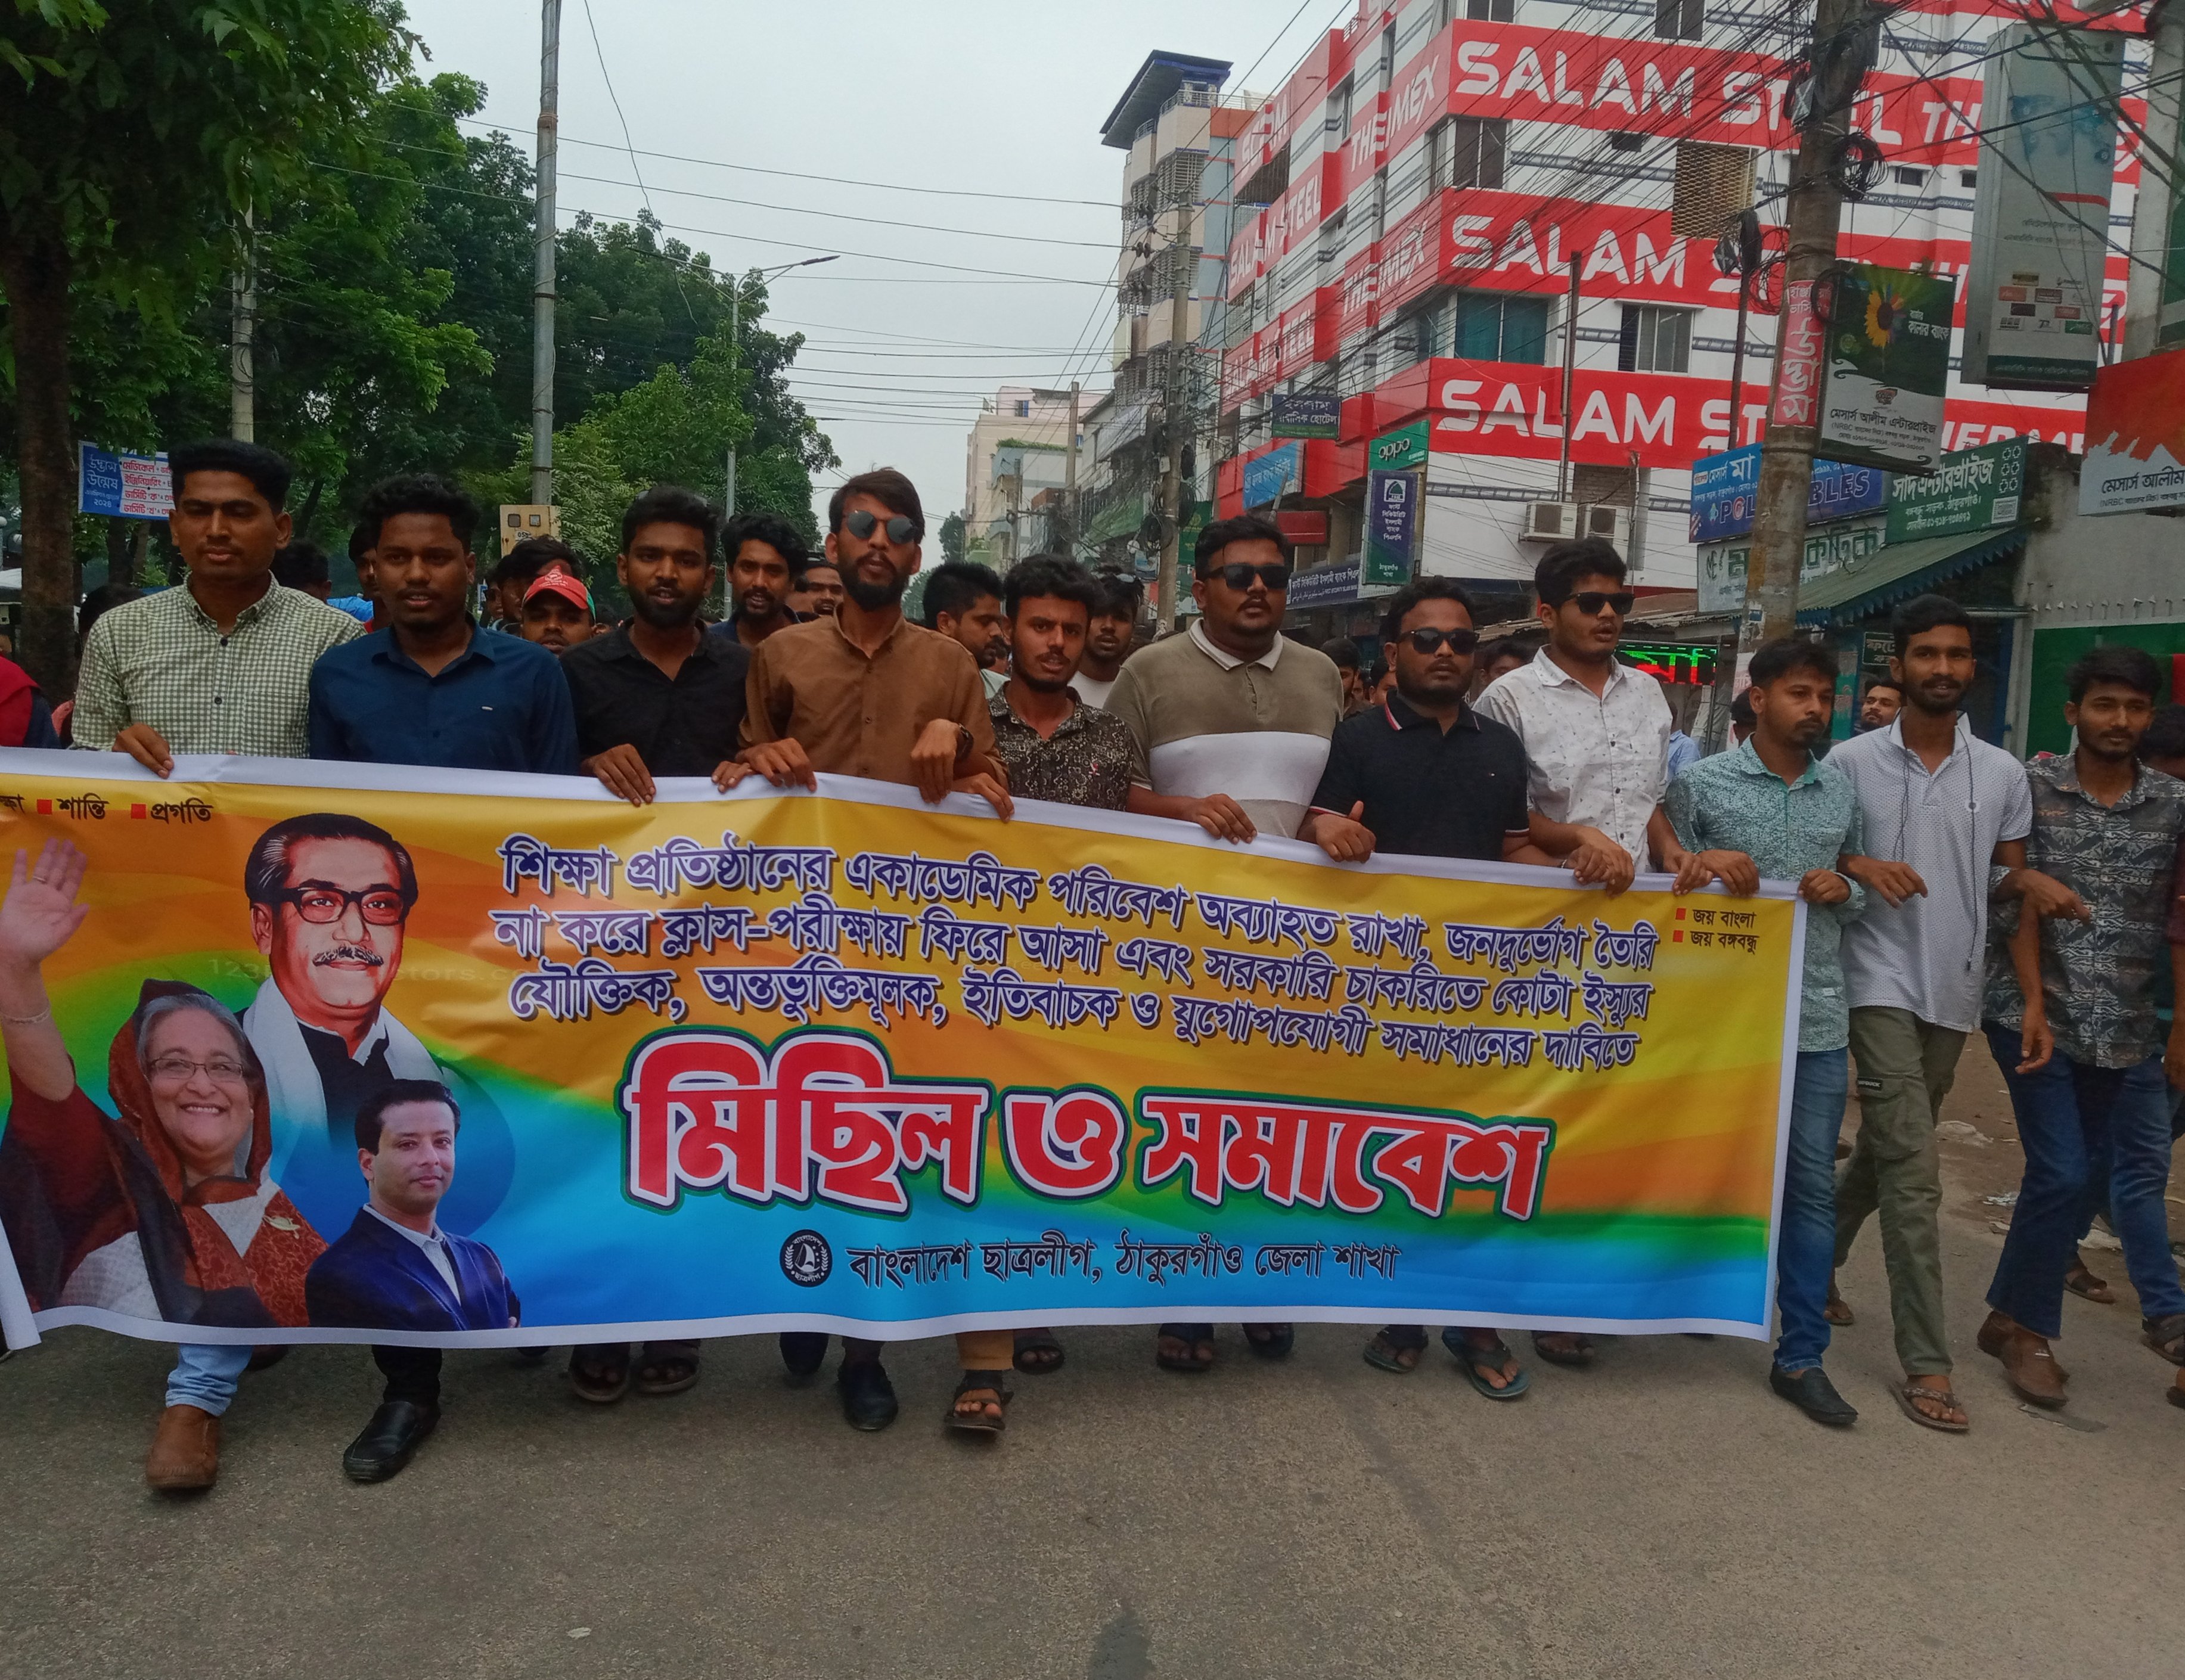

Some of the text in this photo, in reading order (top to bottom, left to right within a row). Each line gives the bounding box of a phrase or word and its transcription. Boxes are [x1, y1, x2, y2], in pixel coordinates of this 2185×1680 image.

[1455, 40, 1695, 119] SALAM
[1719, 70, 1902, 145] STEL
[1451, 214, 1687, 288] SALAM
[1436, 379, 1676, 445] SALAM
[1830, 408, 1937, 434] মেসার্স আলীম এন্টারপ্রাইজ
[1378, 438, 1411, 461] oppo
[1730, 453, 1756, 481] মা
[1808, 470, 1870, 507] BLES
[2102, 465, 2185, 493] মেসার্স আলীম
[57, 793, 109, 820] শান্তি
[150, 797, 213, 824] প্রগতি
[496, 831, 1661, 973] শিক্ষা প্রতিষ্ঠানের একাডেমিক পরিবেশ অব্যাহত রাখা, জনদুর্ভোগ তৈরি
[1692, 909, 1757, 929] জয় বাংলা
[489, 904, 550, 957] না
[552, 910, 655, 955] করে
[657, 892, 914, 957] ক্লাস-পরীক্ষায়
[916, 903, 1013, 964] ফিরে
[1015, 921, 1108, 973] আসা
[1115, 936, 1194, 986] এবং
[1202, 946, 1339, 1000] সরকারি
[1343, 960, 1488, 1011] চাকরিতে
[1492, 968, 1576, 1018] কোটা
[1581, 970, 1653, 1027] ইস্যুর
[1690, 930, 1760, 955] জয় বঙ্গবন্ধু
[508, 957, 687, 1021] যৌক্তিক,
[695, 952, 946, 1029] অন্তর্ভুক্তিমূলক,
[960, 964, 1123, 1027] ইতিবাচক
[1130, 991, 1160, 1027] ও
[1169, 994, 1375, 1055] যুগোপযোগী
[1380, 1020, 1537, 1066] সমাধানের
[1542, 1020, 1641, 1071] দাবিতে
[623, 1033, 1551, 1221] মিছিল ও সমাবেশ
[845, 1229, 1402, 1290] বাংলাদেশ ছাত্রলীগ, ঠাকুরগাঁও জেলা শাখা
